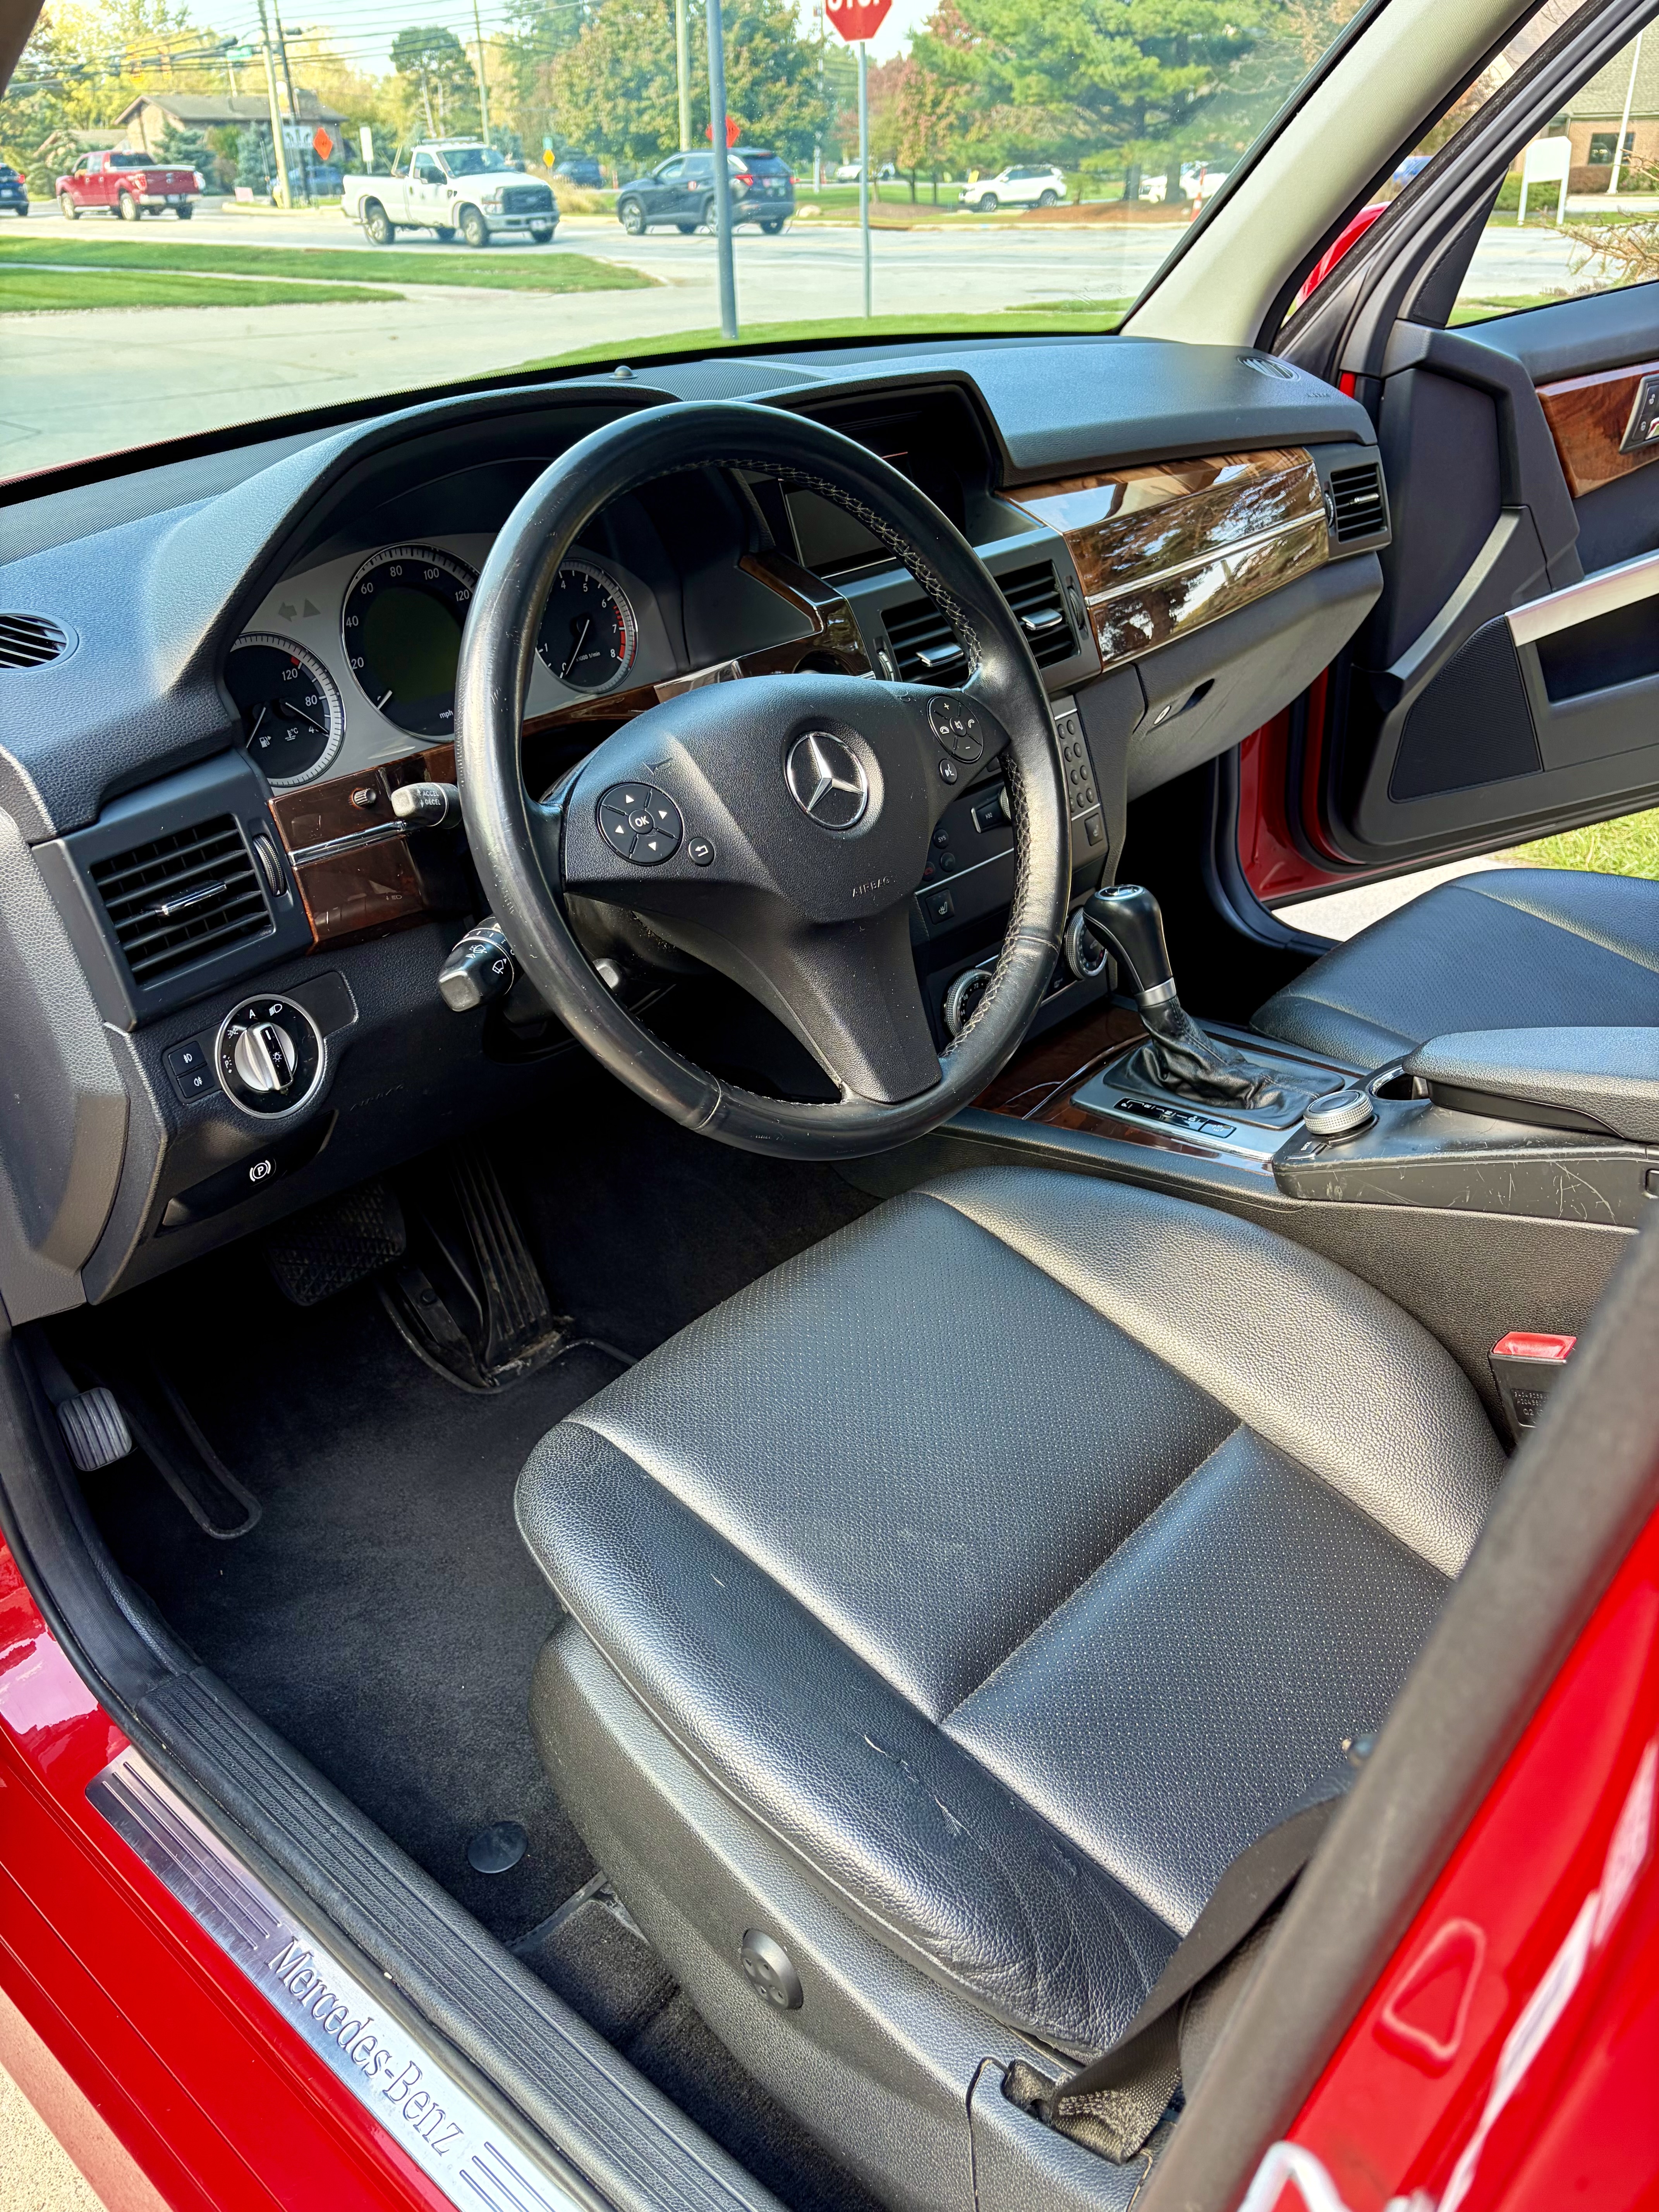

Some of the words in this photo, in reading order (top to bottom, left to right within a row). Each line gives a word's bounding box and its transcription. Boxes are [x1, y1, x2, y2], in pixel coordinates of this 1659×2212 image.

[390, 565, 402, 577] 80
[424, 568, 439, 580] 100
[361, 582, 373, 594] 60
[561, 580, 566, 589] 4
[583, 583, 588, 592] 5
[455, 589, 469, 601] 120
[602, 599, 607, 608] 6
[346, 616, 359, 627] 40
[612, 624, 617, 633] 7
[544, 643, 548, 652] 1
[610, 649, 616, 658] 8
[351, 657, 364, 670] 20
[282, 668, 298, 681] 120
[305, 695, 317, 706] 80
[439, 709, 453, 718] mph
[635, 816, 649, 827] OK
[853, 876, 890, 898] AIRBAG
[249, 1009, 256, 1019] A
[265, 1936, 464, 2156] Mercedes-Benz
